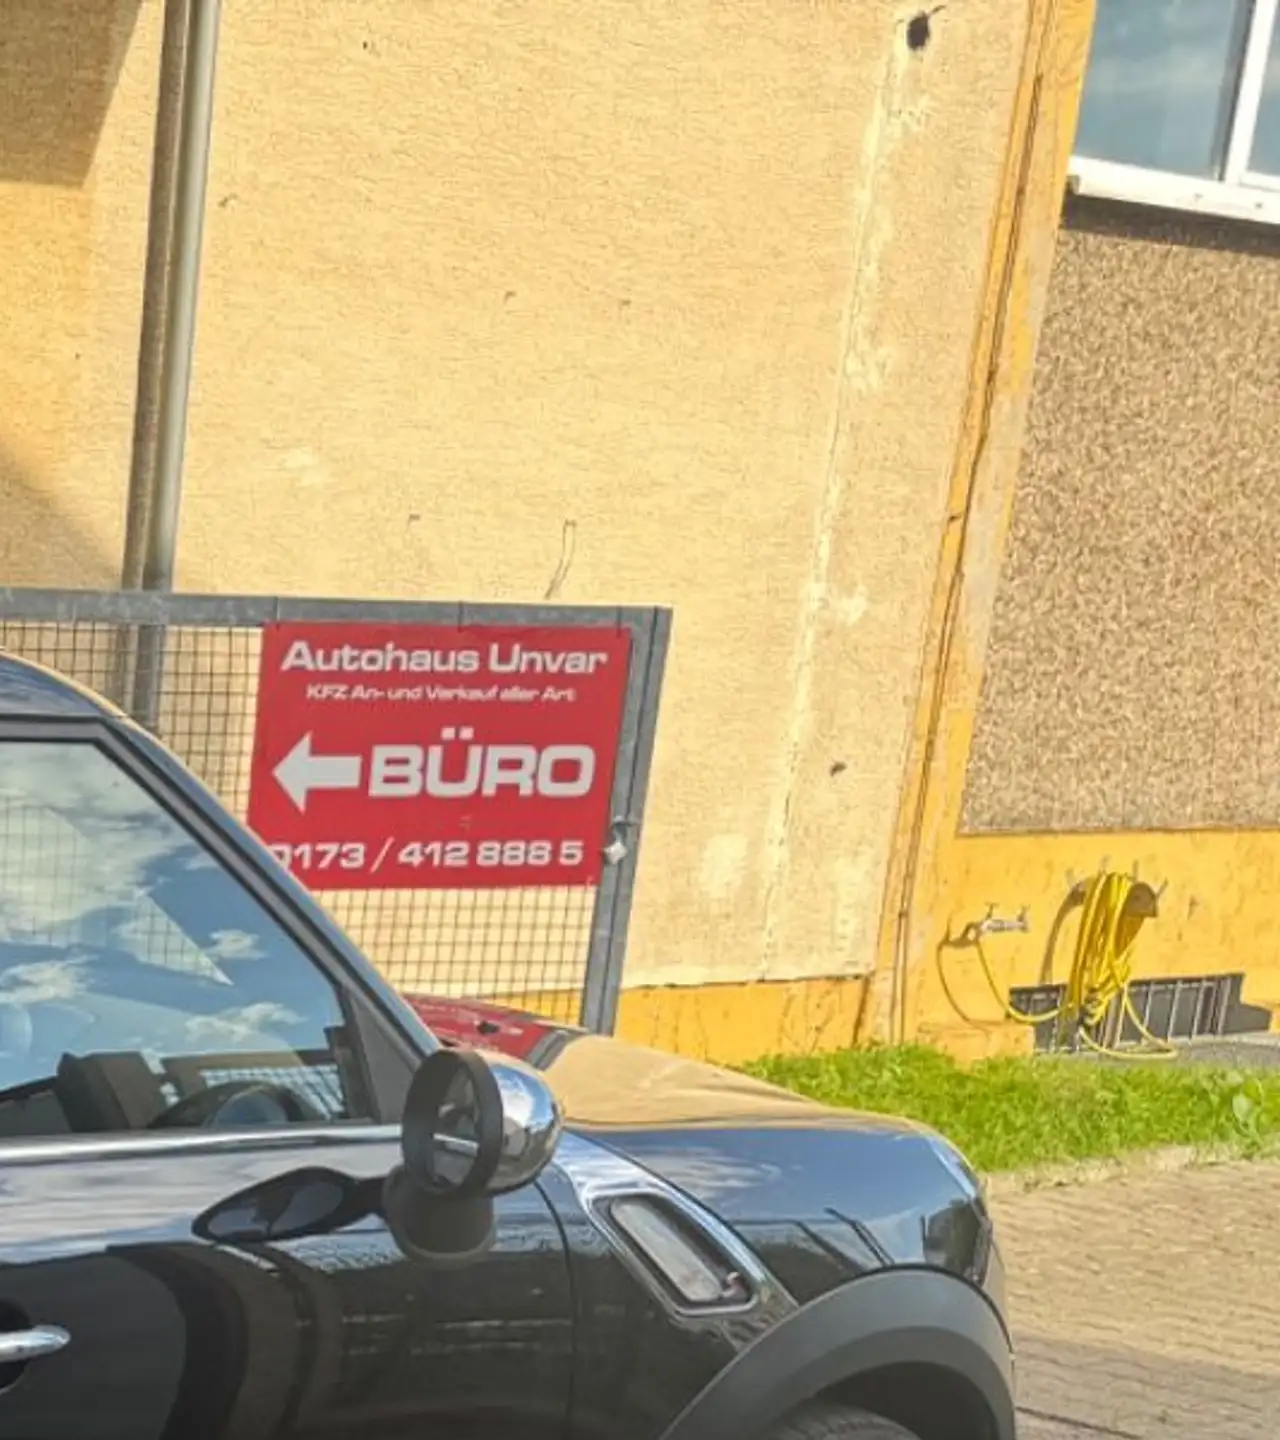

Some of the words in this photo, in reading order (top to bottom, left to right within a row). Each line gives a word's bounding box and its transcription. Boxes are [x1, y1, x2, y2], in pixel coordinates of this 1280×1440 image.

[280, 640, 480, 673] Autohaus
[488, 642, 609, 674] Unvar
[306, 683, 349, 700] KFZ
[387, 685, 423, 701] und
[541, 686, 576, 702] Art
[368, 727, 595, 797] BÜRO
[397, 841, 470, 868] 412
[475, 840, 553, 867] 888
[558, 840, 584, 866] 5
